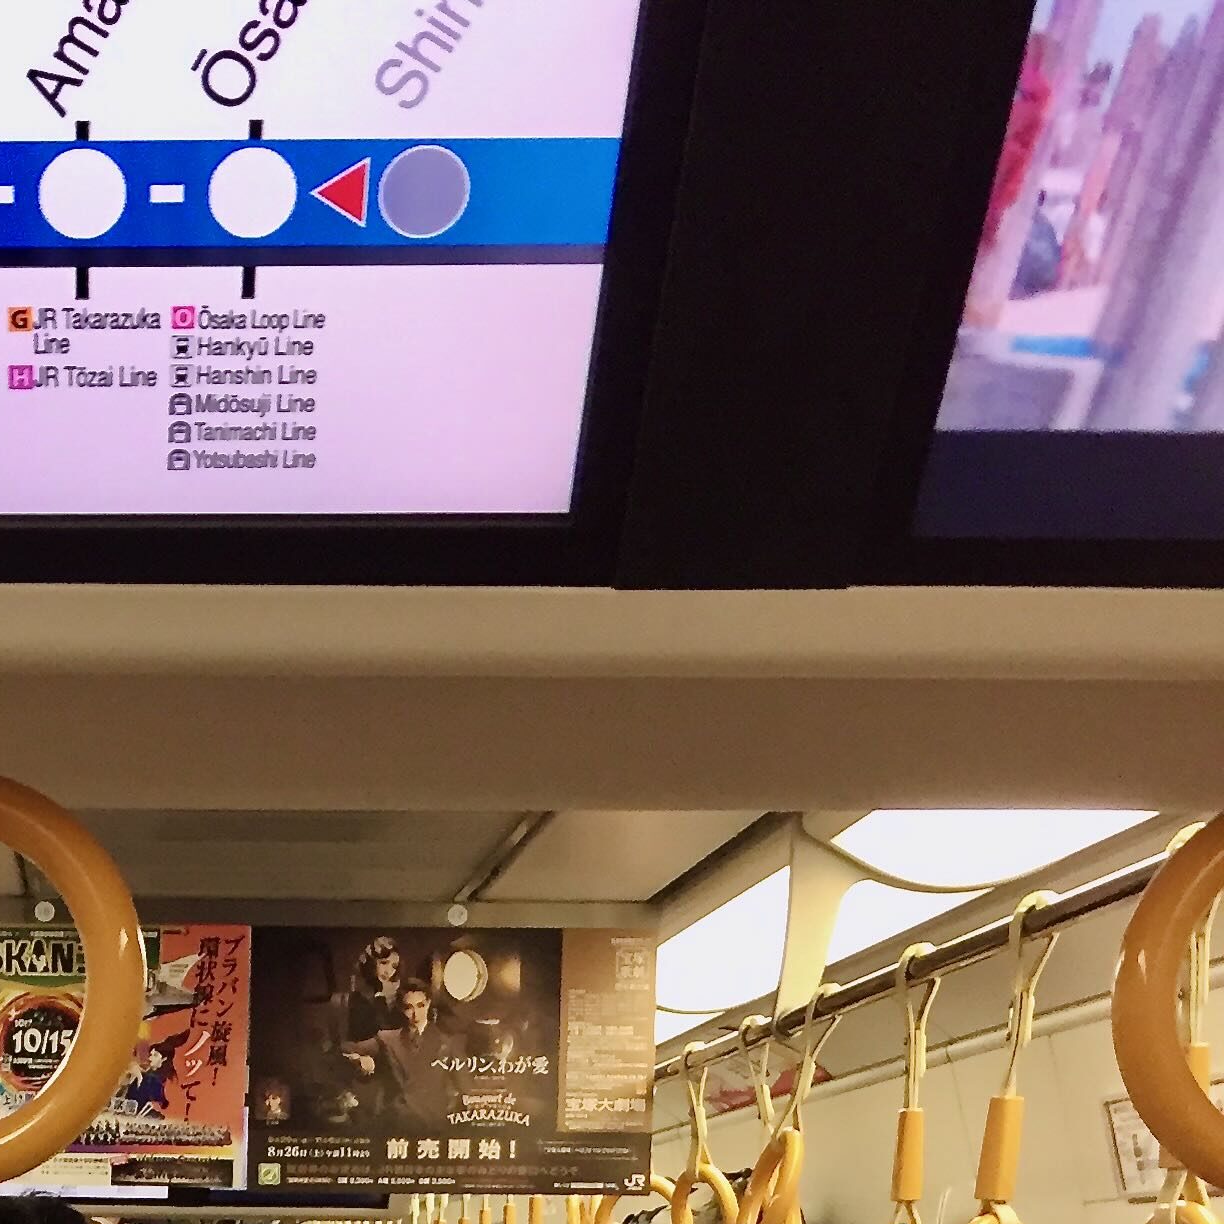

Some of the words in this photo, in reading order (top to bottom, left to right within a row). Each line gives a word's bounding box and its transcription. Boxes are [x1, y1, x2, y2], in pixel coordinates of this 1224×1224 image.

[26, 0, 130, 117] Ama
[191, 0, 309, 107] Ōsa
[10, 308, 29, 330] G
[33, 307, 57, 329] JR
[62, 307, 161, 330] Takarazuka
[198, 305, 247, 329] Ōsaka
[250, 309, 290, 333] Loop
[293, 309, 326, 329] Line
[33, 333, 71, 354] Line
[197, 336, 269, 361] Hankyū
[275, 336, 314, 356] Line
[12, 368, 30, 388] H
[35, 366, 59, 387] JR
[63, 365, 114, 387] Tōzai
[119, 365, 158, 387] Line
[196, 365, 272, 385] Hanshin
[278, 365, 317, 385] Line
[195, 393, 272, 417] Midōsuji
[277, 393, 316, 413] Line
[194, 421, 277, 441] Tanimachi
[281, 421, 317, 441] Line
[193, 449, 278, 469] Yotsubashi
[282, 449, 317, 469] Line
[12, 1027, 74, 1057] 10/15
[446, 1108, 531, 1128] TAKARAZUKA
[623, 1173, 646, 1187] JR
